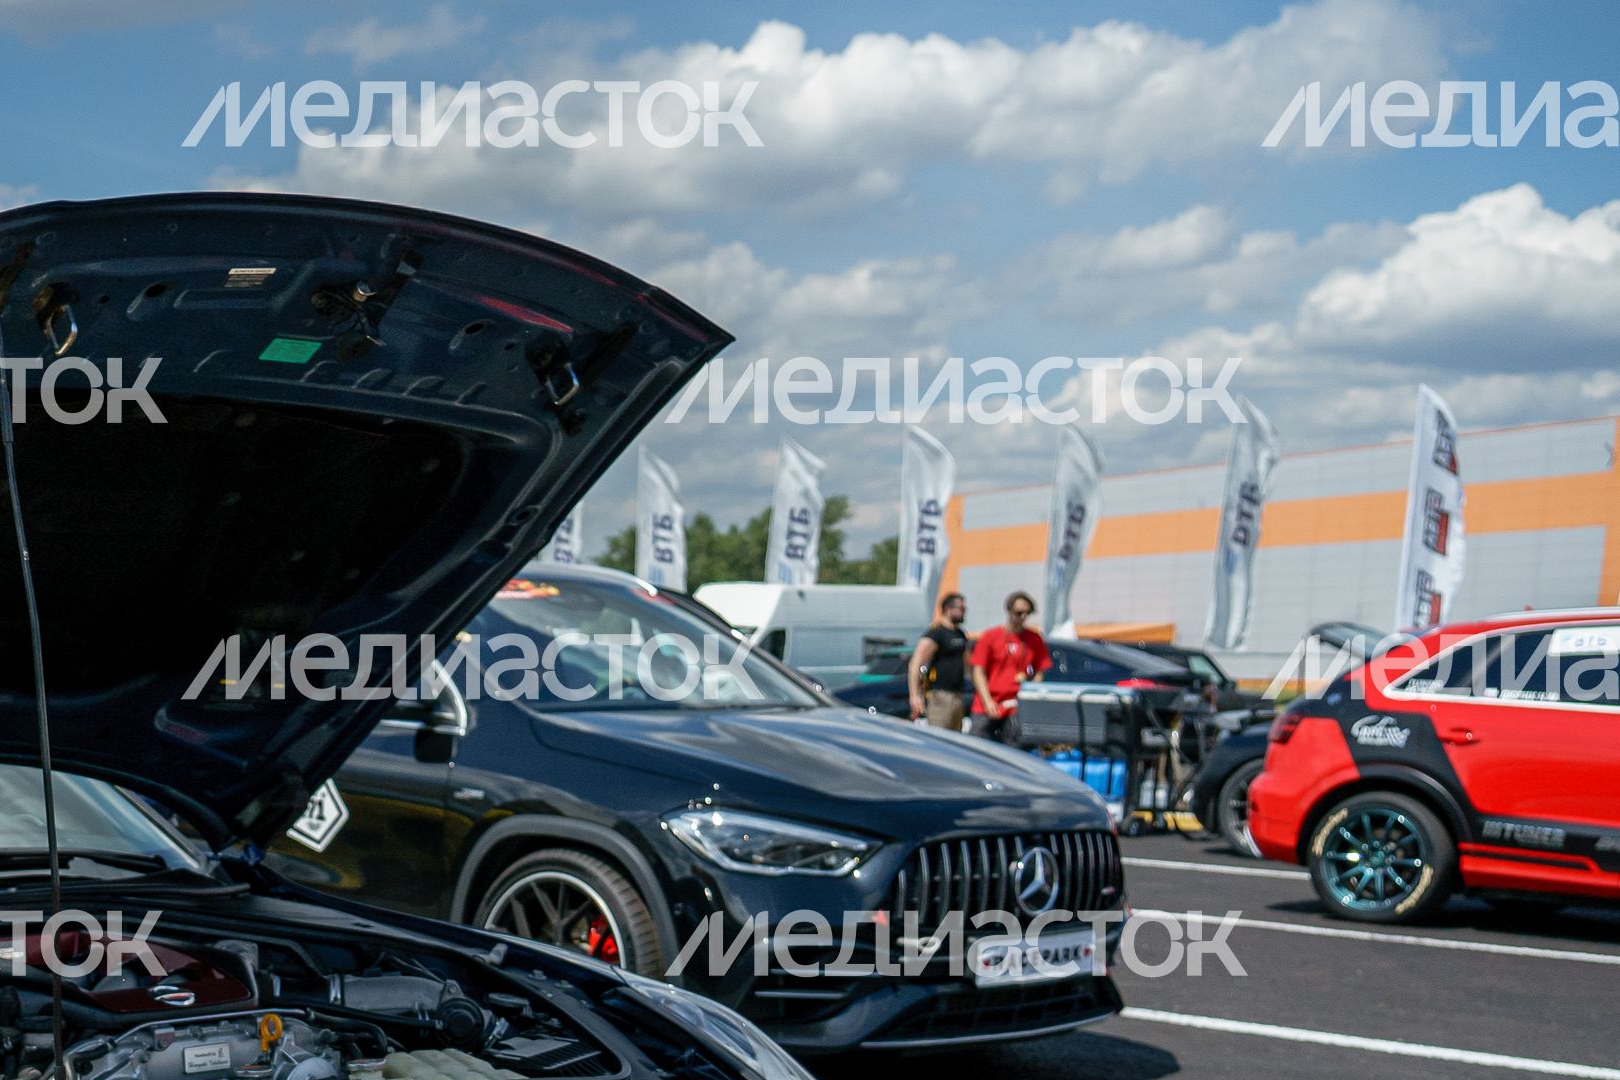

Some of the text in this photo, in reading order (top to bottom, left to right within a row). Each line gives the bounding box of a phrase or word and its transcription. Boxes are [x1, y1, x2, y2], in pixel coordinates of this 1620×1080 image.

[652, 513, 674, 564] ВТБ
[785, 507, 811, 561] ВТБ
[917, 499, 942, 556] ВТБ
